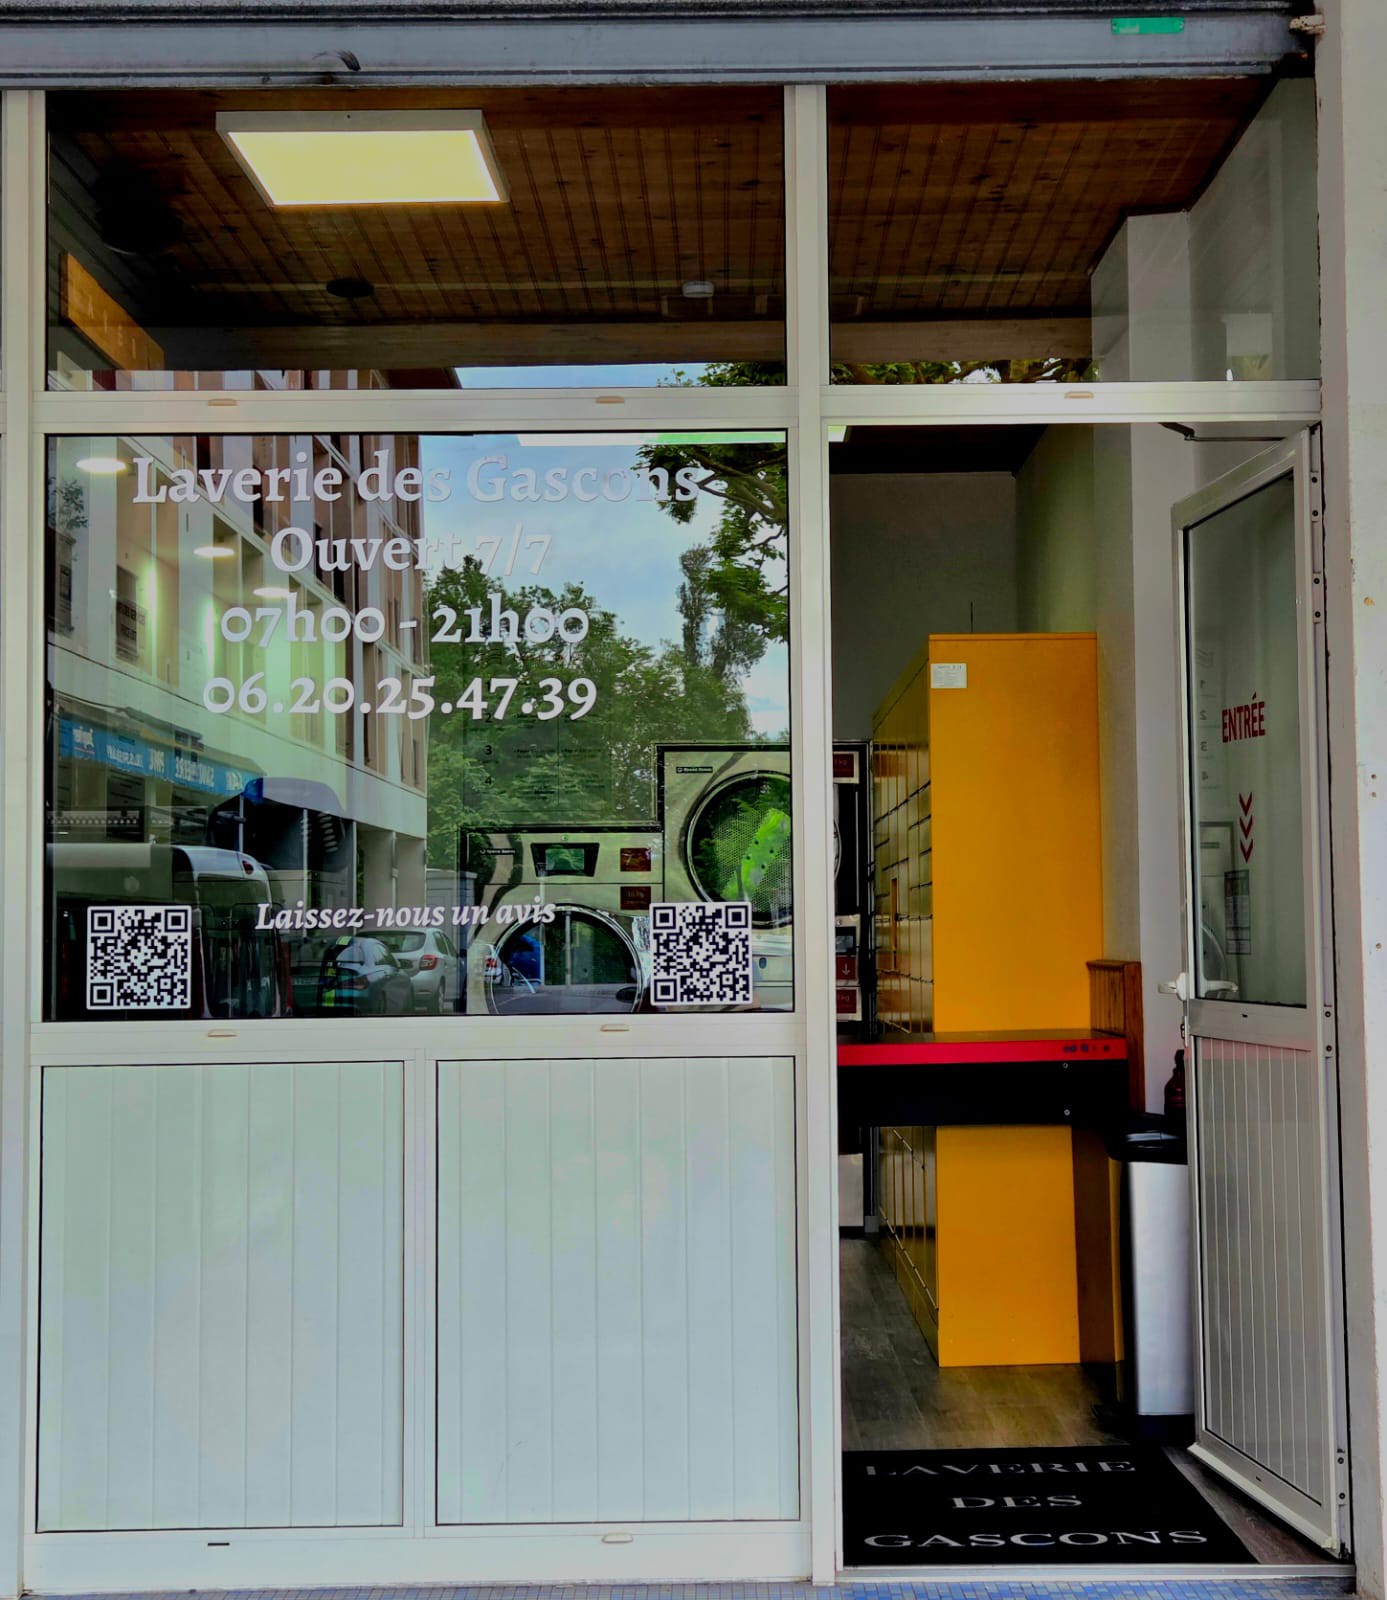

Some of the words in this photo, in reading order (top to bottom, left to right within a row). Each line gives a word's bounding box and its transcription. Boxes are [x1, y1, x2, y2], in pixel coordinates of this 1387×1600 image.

[133, 451, 343, 503] Laverie
[357, 449, 452, 502] des
[467, 454, 702, 502] Gascons
[270, 527, 462, 573] Ouvert
[475, 522, 552, 577] 7/7
[221, 592, 386, 648] 07h00
[400, 620, 418, 629] -
[431, 593, 590, 643] 21h00
[203, 671, 597, 721] 06.20.25.47.39
[1221, 691, 1266, 743] ENTRÉE
[255, 901, 446, 930] Laissez-nous
[452, 904, 489, 926] un
[496, 896, 557, 924] avis
[865, 1461, 1137, 1476] LAVERIE
[952, 1495, 1083, 1510] DES
[863, 1530, 1208, 1548] GASCONS
